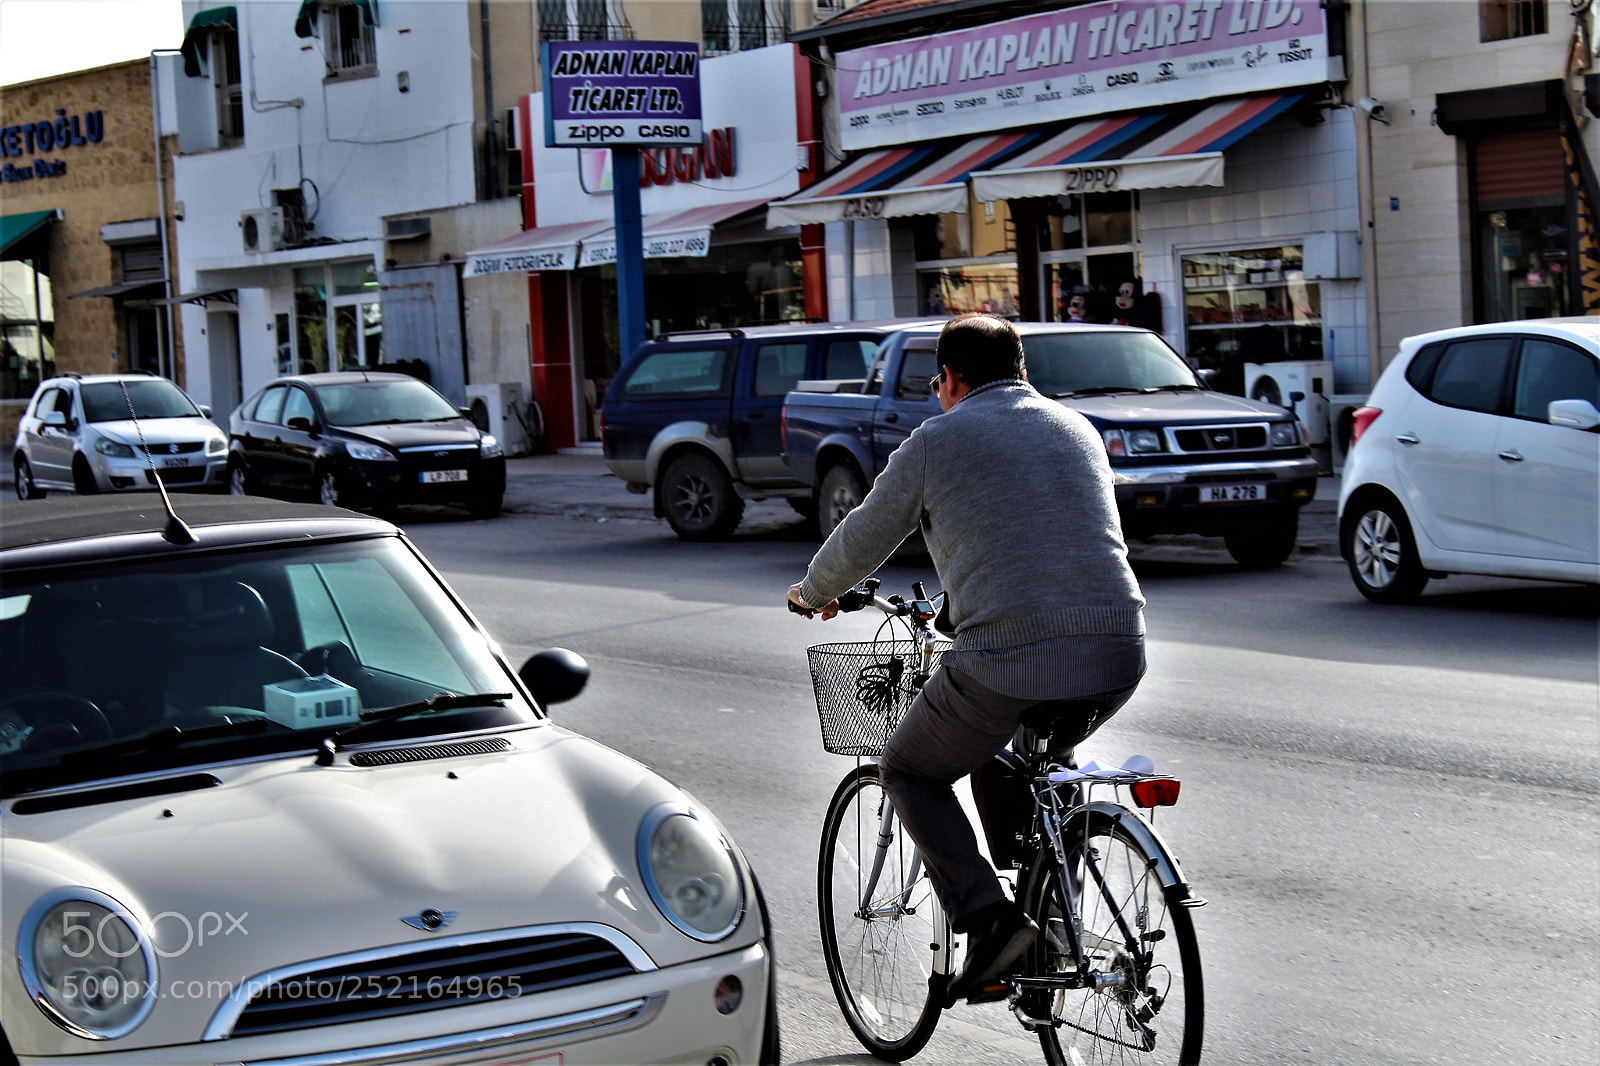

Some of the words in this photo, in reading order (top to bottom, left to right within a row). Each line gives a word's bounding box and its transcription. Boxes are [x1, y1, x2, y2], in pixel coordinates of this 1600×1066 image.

[853, 46, 954, 100] ADNAN
[959, 22, 1080, 81] KAPLAN
[1087, 2, 1224, 60] TİCARET
[1278, 48, 1313, 63] TISSOT
[552, 51, 626, 77] ADNAN
[629, 52, 697, 78] KAPLAN
[1106, 71, 1139, 87] CASIO
[569, 80, 647, 113] TİCARET
[648, 87, 684, 114] LTD.
[568, 124, 625, 142] zippo
[638, 125, 690, 138] CASIO
[1211, 487, 1227, 500] HA
